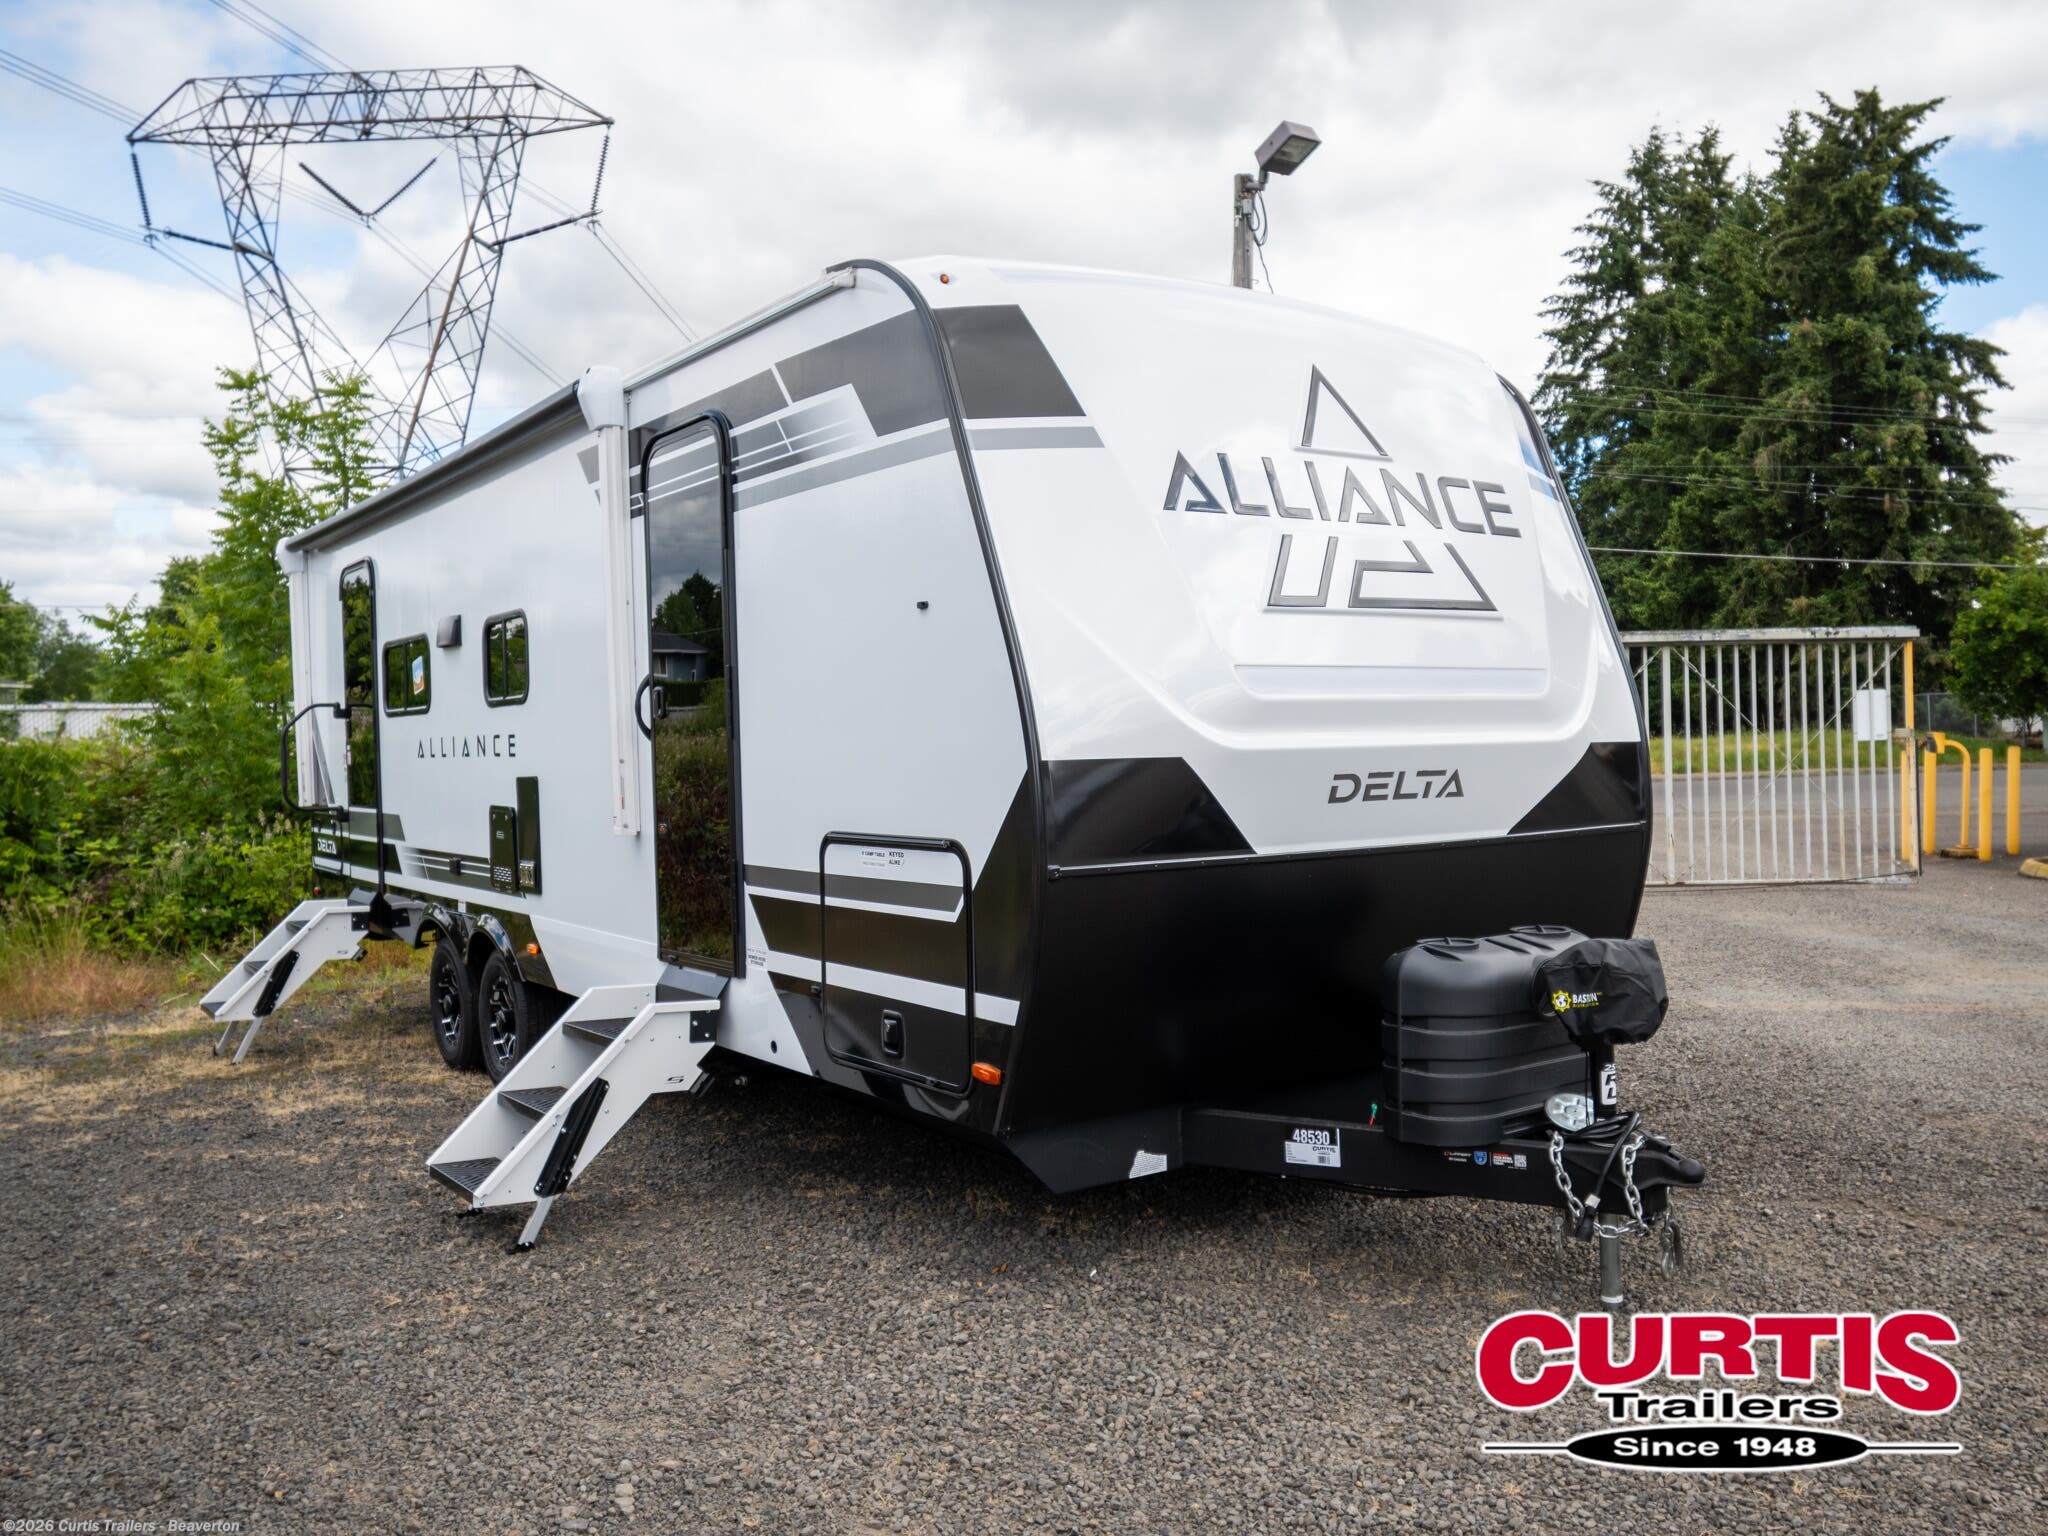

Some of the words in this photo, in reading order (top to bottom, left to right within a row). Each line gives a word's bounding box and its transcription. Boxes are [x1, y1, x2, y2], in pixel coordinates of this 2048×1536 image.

[1163, 450, 1522, 538] ALLIANCE
[418, 734, 516, 758] ALLIANCE
[1328, 768, 1465, 804] DELTA
[317, 838, 337, 855] DELTA
[1292, 1129, 1330, 1145] 48530
